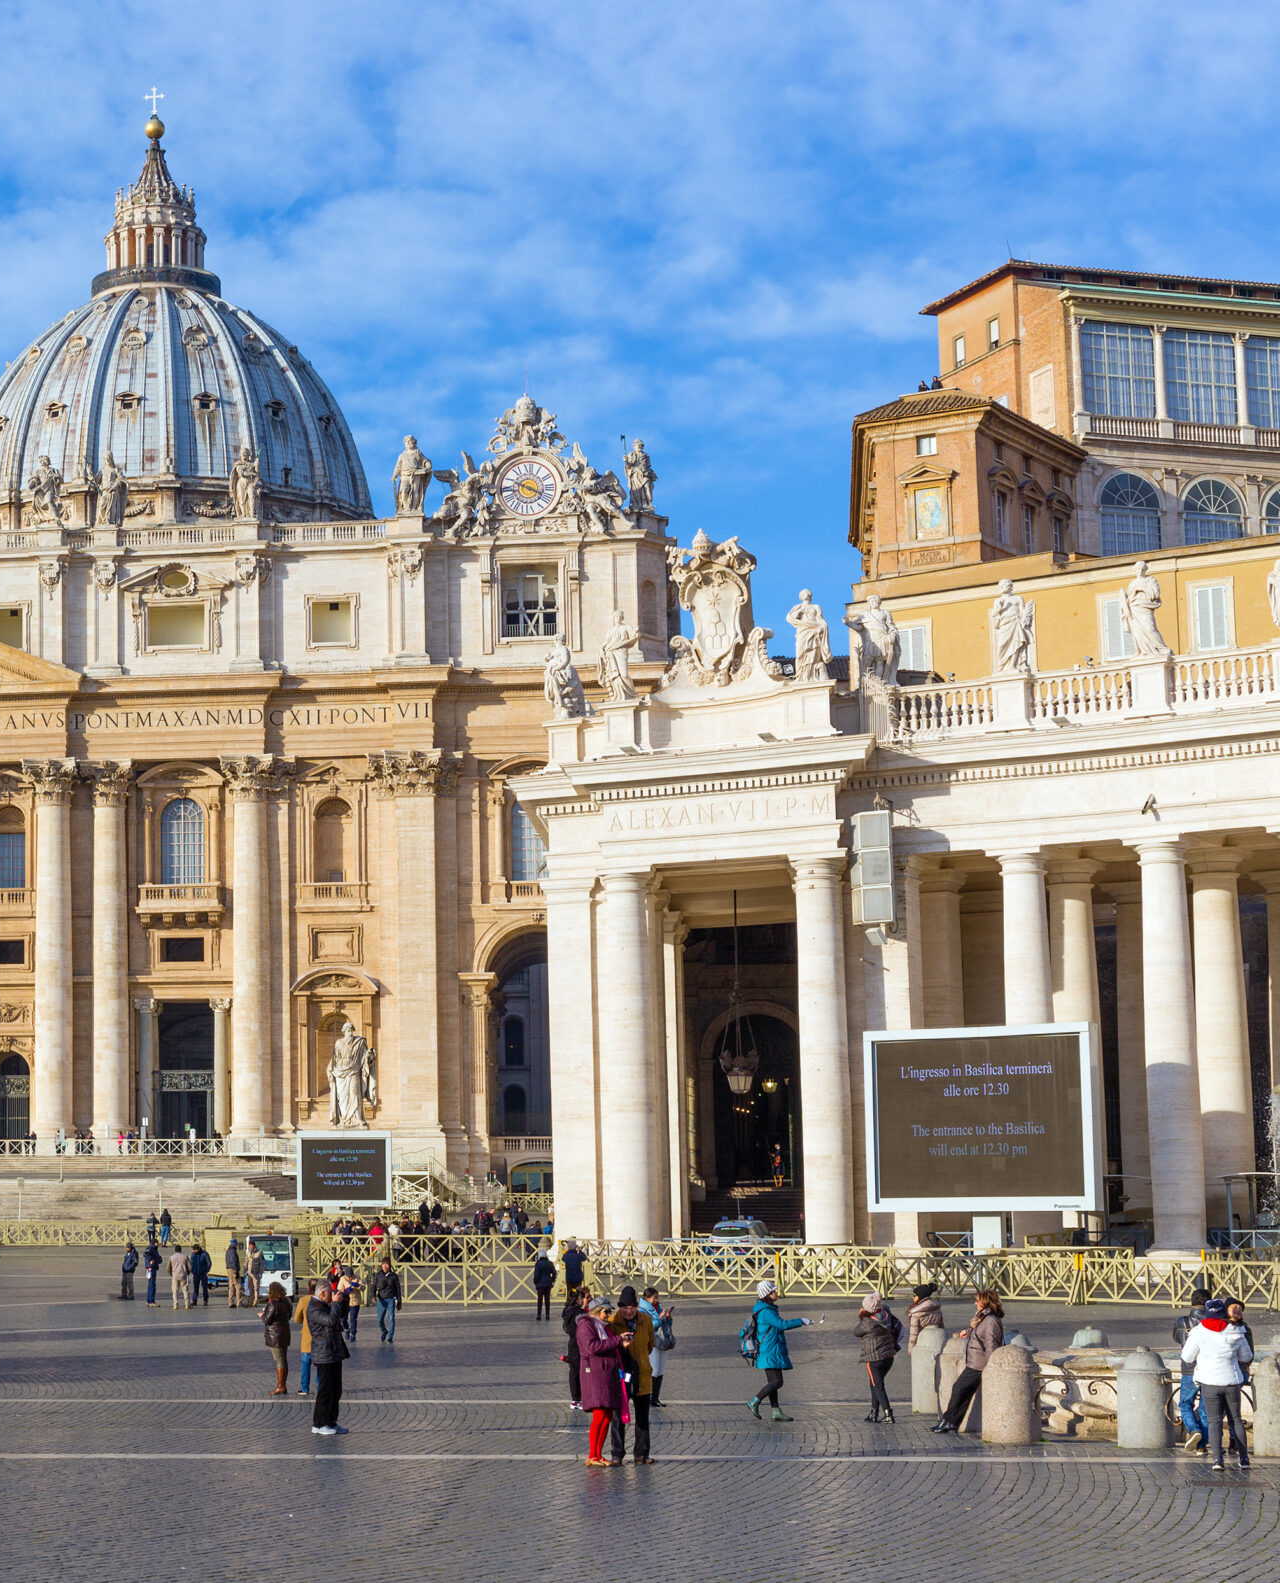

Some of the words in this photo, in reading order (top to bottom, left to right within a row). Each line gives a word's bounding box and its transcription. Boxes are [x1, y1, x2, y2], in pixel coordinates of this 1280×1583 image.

[74, 711, 134, 730] PONT
[136, 710, 185, 728] MAX
[190, 709, 221, 727] AN
[329, 706, 392, 725] PONT
[397, 702, 430, 719] VII
[608, 802, 715, 833] ALEXAN
[783, 796, 797, 818] P
[809, 792, 832, 816] M
[900, 1065, 950, 1081] L'ingresso
[952, 1064, 962, 1077] in
[964, 1063, 1003, 1077] Basilica
[1005, 1061, 1053, 1076] terminerà
[943, 1083, 961, 1097] alle
[963, 1086, 979, 1096] ore
[983, 1082, 1010, 1096] 12.30
[911, 1124, 930, 1137] The
[932, 1125, 973, 1137] entrance
[975, 1125, 986, 1136] to
[988, 1122, 1003, 1136] the
[1005, 1121, 1045, 1135] Basilica
[928, 1143, 948, 1157] will
[950, 1143, 968, 1156] end
[970, 1144, 980, 1156] at
[982, 1142, 1010, 1156] 12.30
[1011, 1145, 1028, 1159] pm
